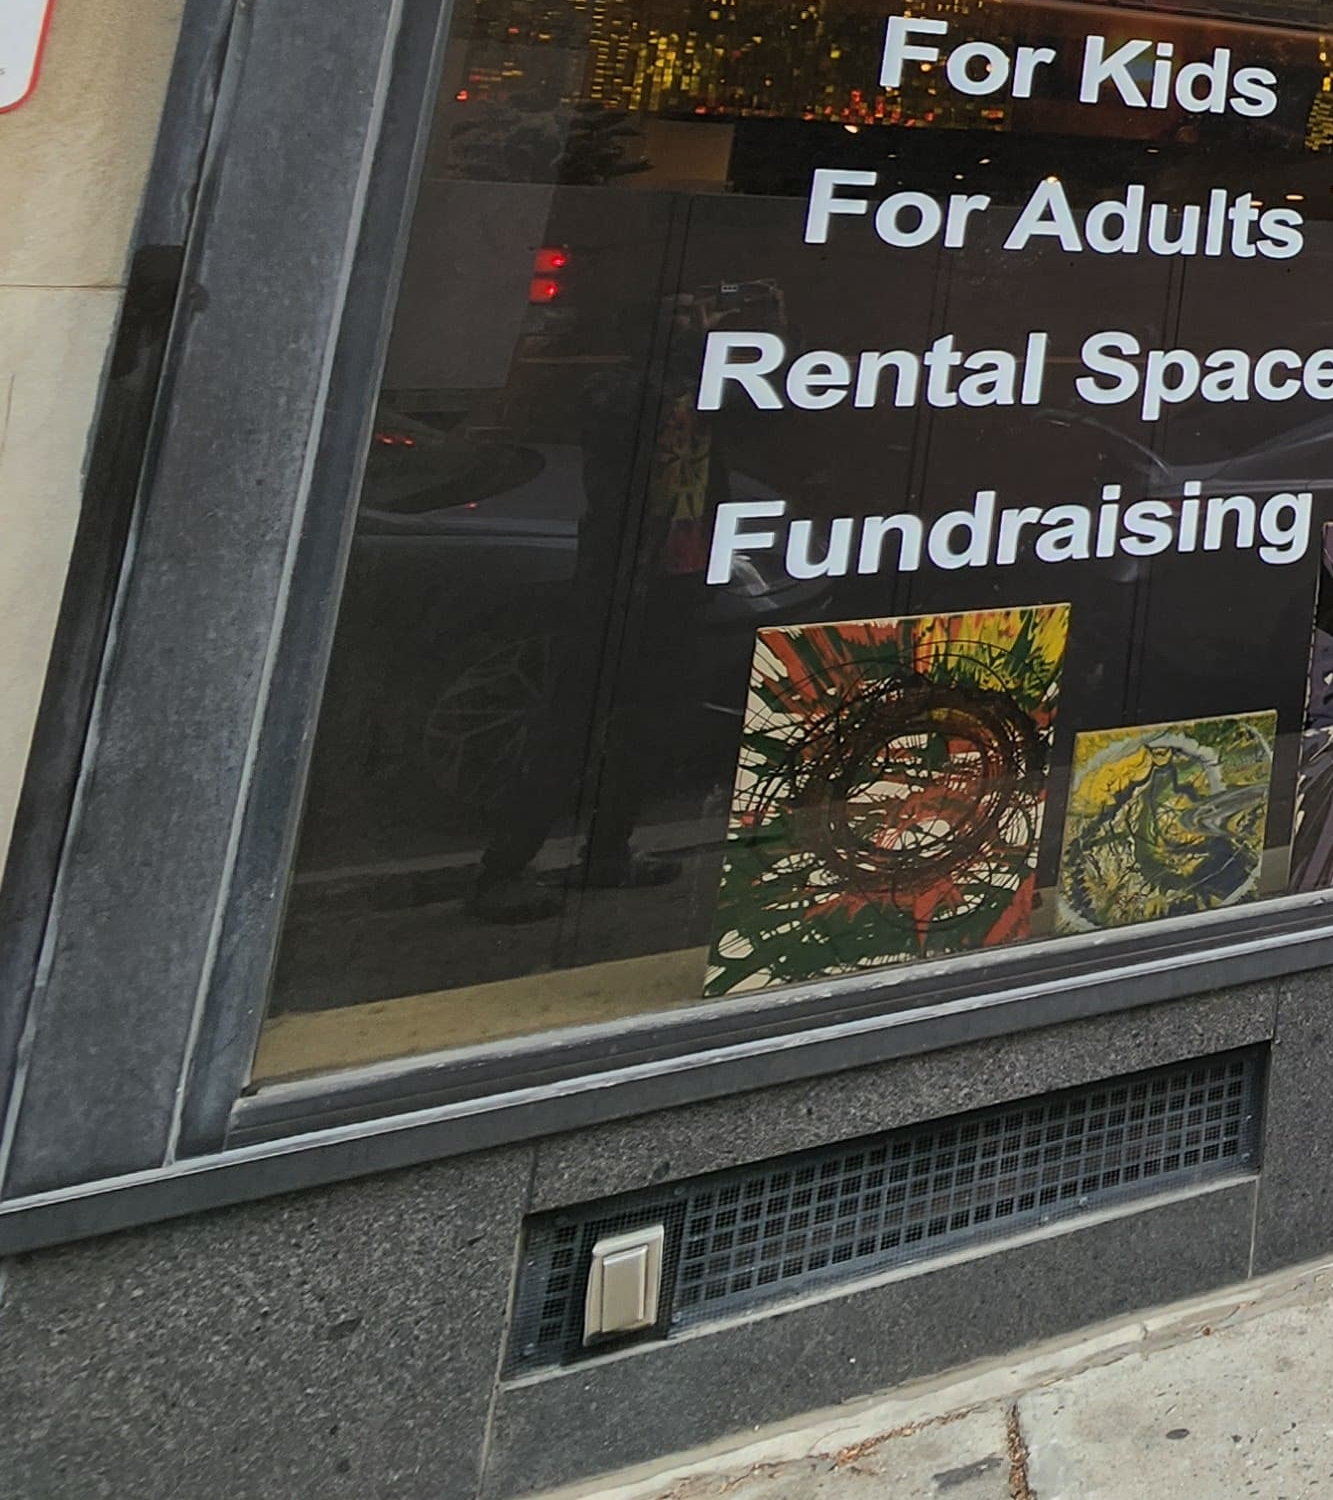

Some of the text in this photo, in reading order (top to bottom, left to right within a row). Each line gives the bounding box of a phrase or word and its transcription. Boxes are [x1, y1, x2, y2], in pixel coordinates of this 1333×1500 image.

[879, 16, 1279, 117] For Kids
[803, 168, 1306, 260] For Adults
[695, 330, 1047, 411] Rental
[705, 482, 1314, 585] Fundraising
